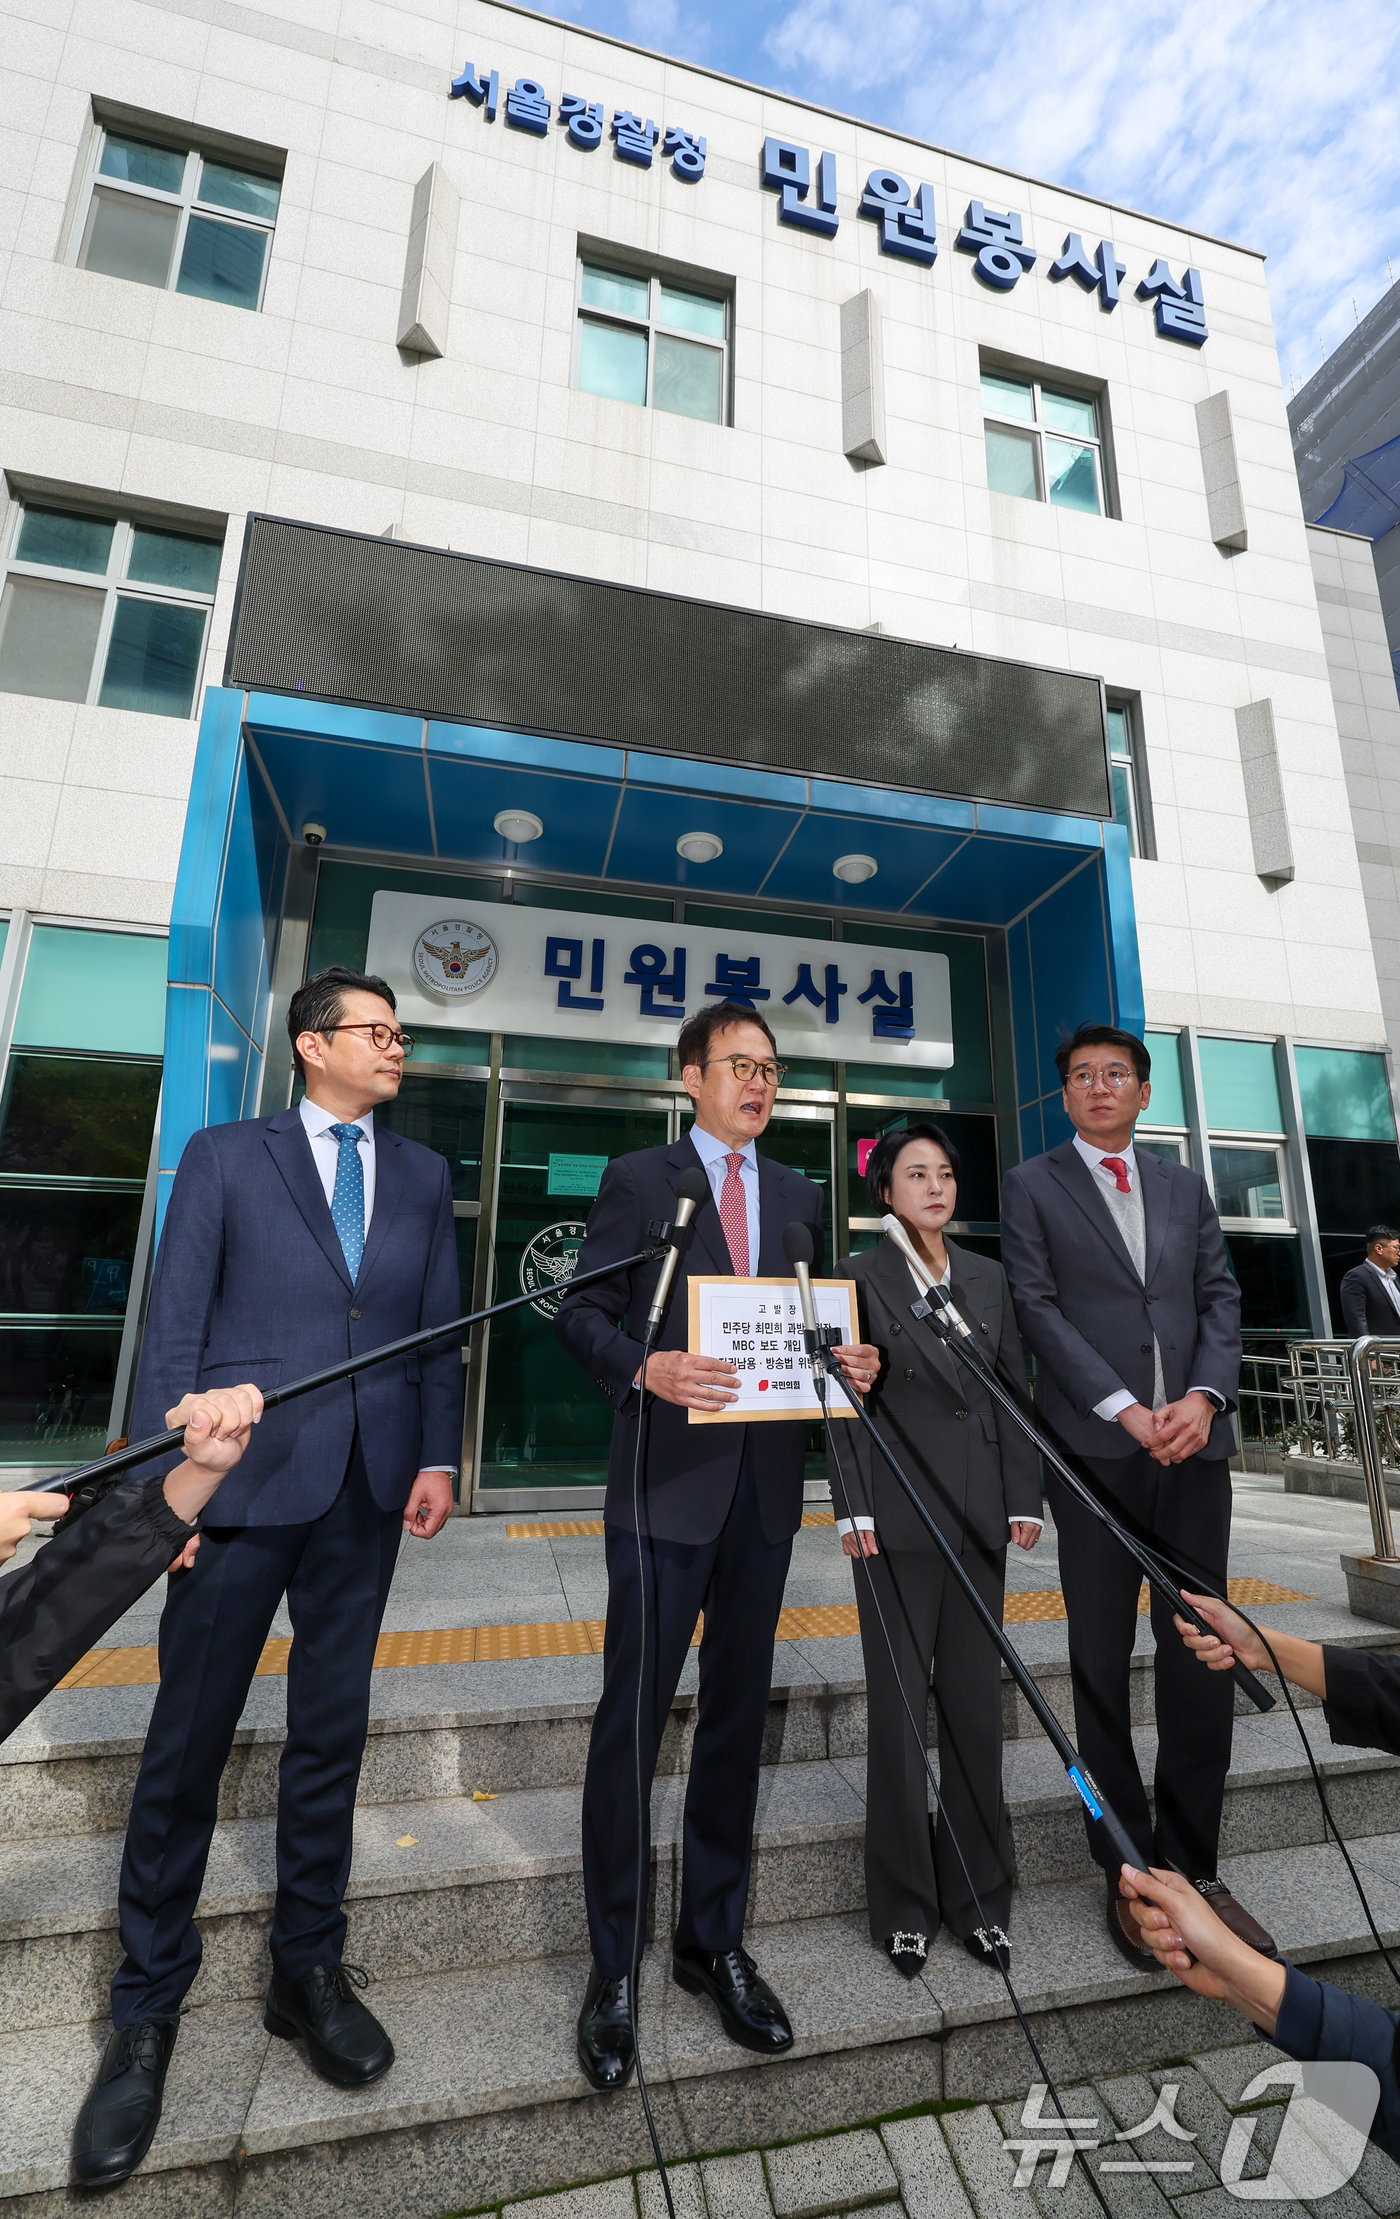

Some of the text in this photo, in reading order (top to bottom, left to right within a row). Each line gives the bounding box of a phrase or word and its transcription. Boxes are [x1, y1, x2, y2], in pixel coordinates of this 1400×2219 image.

[451, 61, 1211, 348] 서울경찰청 민원봉사실
[431, 923, 484, 940] 서울경찰청
[418, 951, 494, 992] SEOUL METROPOLITAN POLICE AGENCY
[543, 934, 917, 1041] 민원봉사실
[722, 1321, 751, 1335] 민주당
[755, 1321, 783, 1335] 최민희
[732, 1339, 801, 1352] MBC 보도 개입
[771, 1380, 800, 1390] 국민의힘
[1070, 1774, 1092, 1808] Channel
